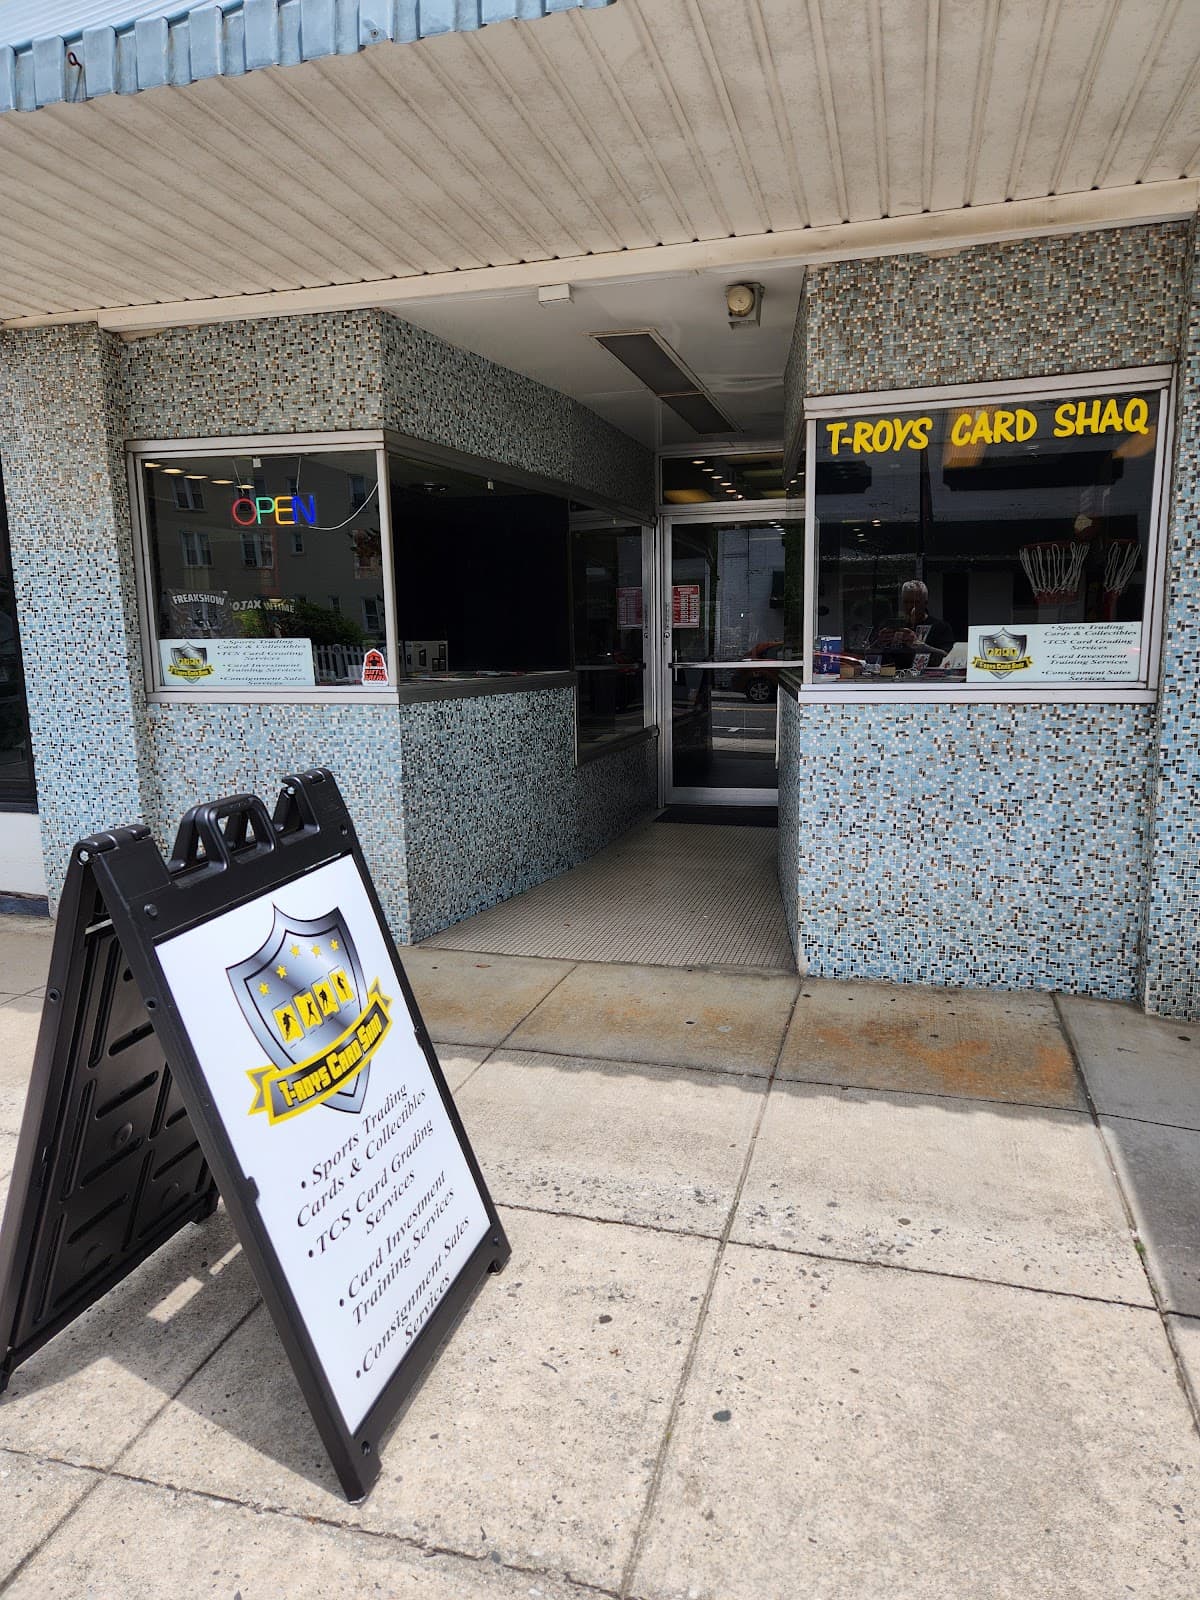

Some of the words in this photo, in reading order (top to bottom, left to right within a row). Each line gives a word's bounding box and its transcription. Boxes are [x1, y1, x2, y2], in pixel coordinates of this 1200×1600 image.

[826, 417, 932, 455] T-ROYS
[951, 409, 1037, 447] CARD
[1053, 398, 1149, 438] SHAQ
[231, 495, 317, 526] OPEN
[172, 593, 225, 607] FREAKSHOW
[297, 1177, 345, 1228] Cards
[350, 1157, 362, 1178] &
[366, 1088, 426, 1160] Collectibles
[312, 1133, 360, 1186] Sports
[362, 1083, 408, 1136] Trading
[316, 1208, 352, 1256] TCS
[356, 1170, 389, 1213] Card
[391, 1119, 434, 1173] Grading
[348, 1247, 383, 1299] Card
[386, 1169, 446, 1256] Investment
[365, 1169, 415, 1235] Services
[352, 1247, 411, 1326] Training
[413, 1187, 454, 1250] Services
[362, 1254, 443, 1373] Consignment
[443, 1215, 470, 1259] Sales
[404, 1272, 451, 1346] Services
